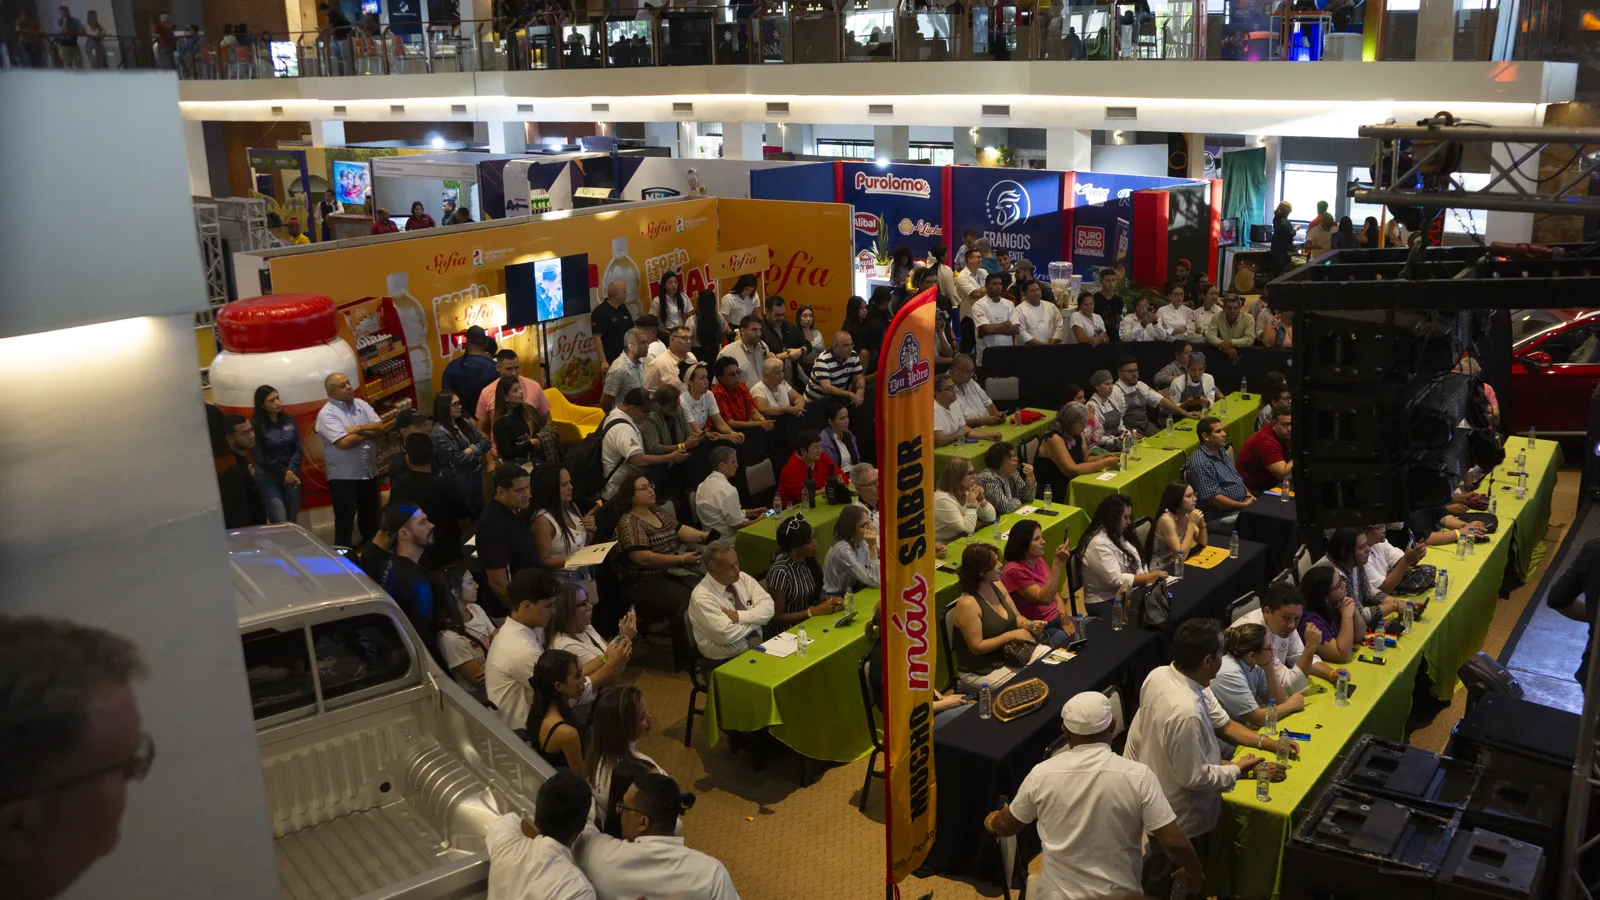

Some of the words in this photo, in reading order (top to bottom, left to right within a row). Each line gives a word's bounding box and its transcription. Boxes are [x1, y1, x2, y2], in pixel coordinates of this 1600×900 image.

[856, 172, 924, 192] Purolomo
[854, 217, 876, 228] Alibal
[983, 231, 1031, 250] FRANGOS
[1077, 239, 1102, 248] QUESO
[1078, 230, 1102, 240] PURO
[425, 251, 468, 274] Sofía
[721, 252, 758, 272] Sofía
[756, 248, 835, 297] ofía
[890, 378, 905, 392] Don
[906, 369, 929, 387] Pedro
[896, 434, 928, 567] SABOR
[891, 572, 931, 692] más
[908, 701, 931, 824] MUCHO
